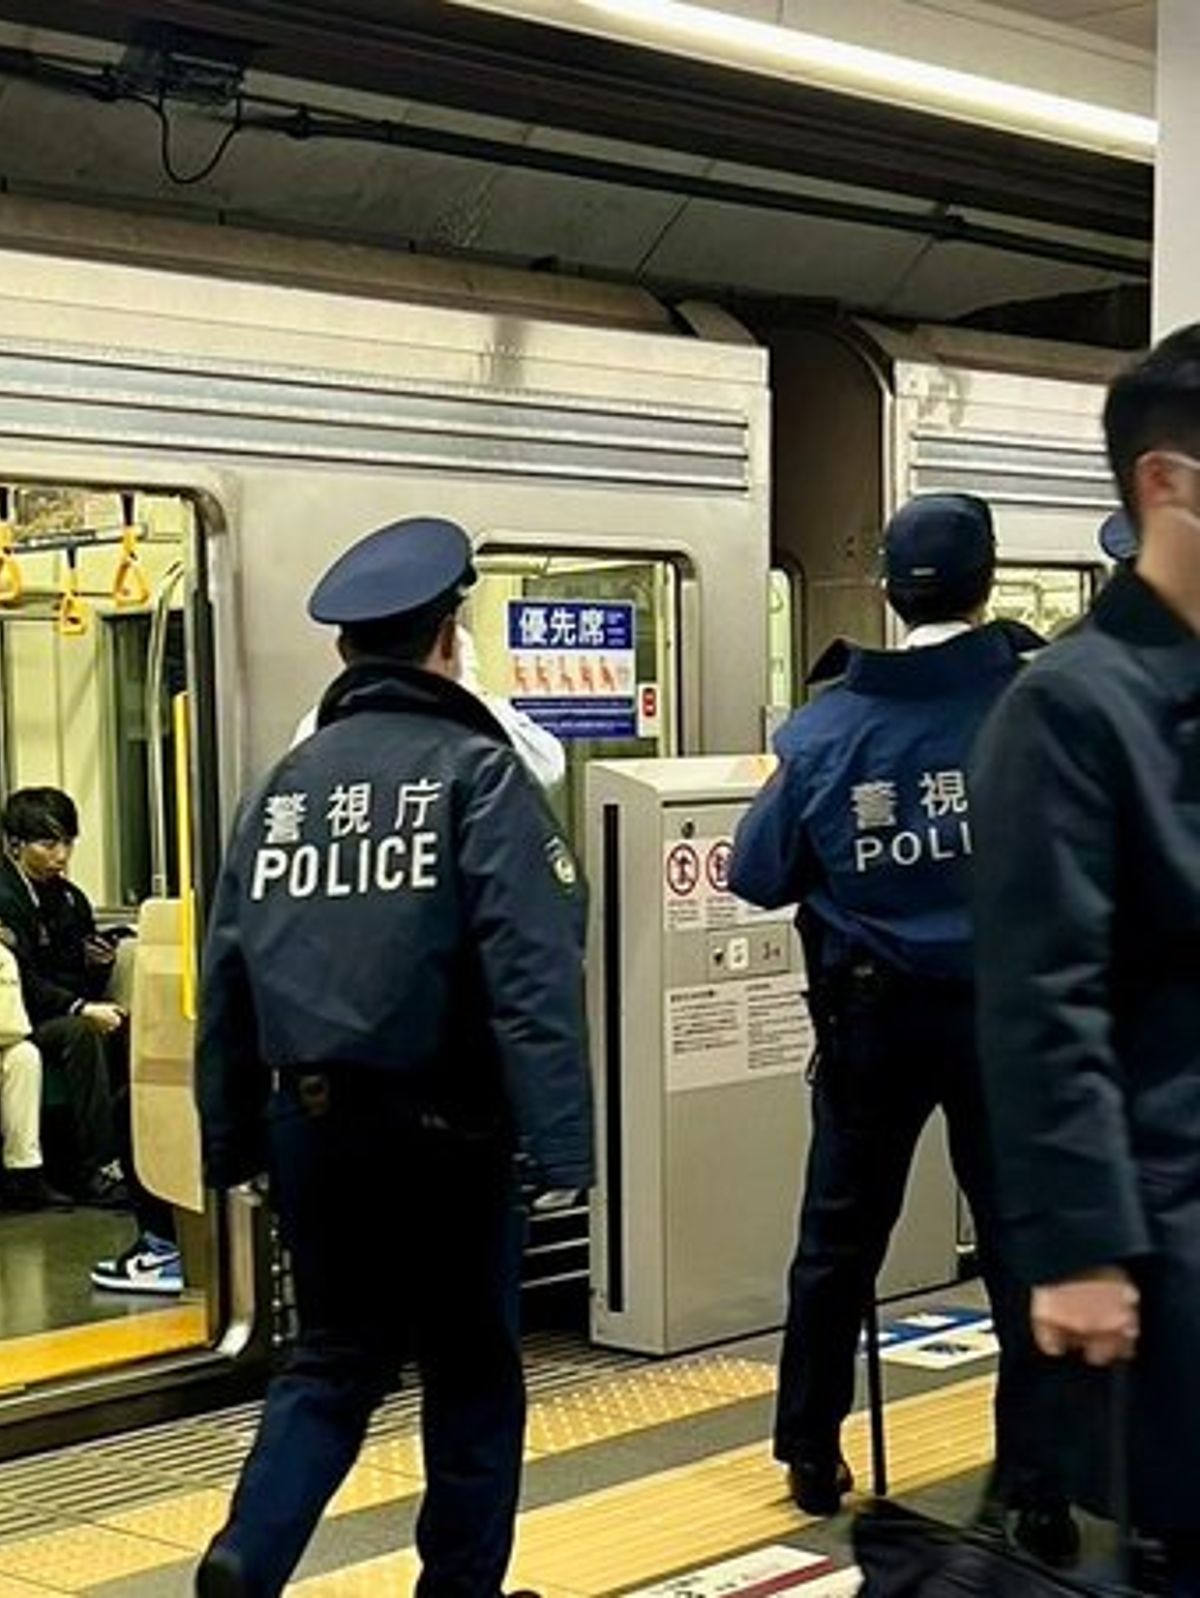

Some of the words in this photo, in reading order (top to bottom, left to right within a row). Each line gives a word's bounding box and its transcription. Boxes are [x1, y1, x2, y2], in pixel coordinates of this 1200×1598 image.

[519, 607, 605, 646] 優先席
[264, 779, 443, 844] 警視庁
[851, 771, 968, 830] 警視
[251, 832, 437, 899] POLICE
[855, 821, 973, 872] POLI
